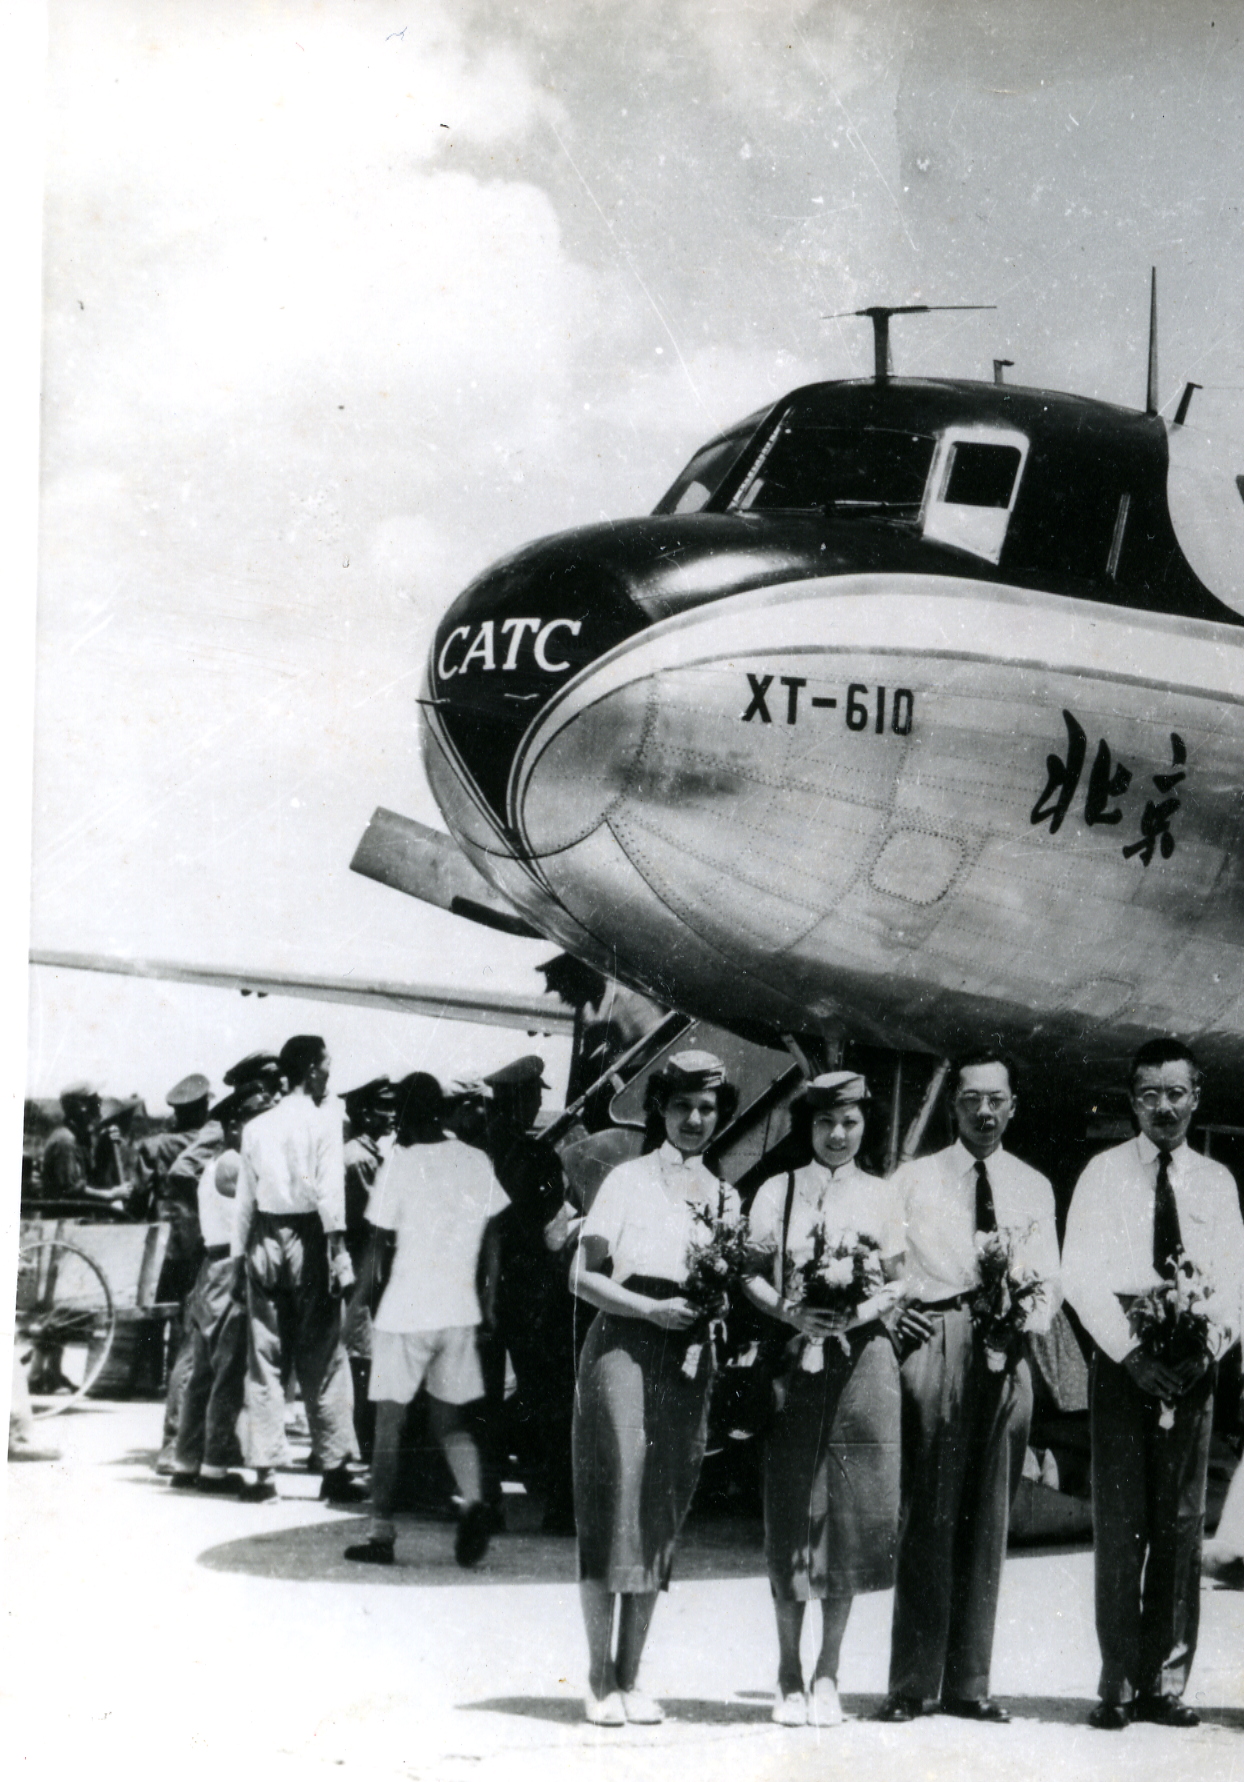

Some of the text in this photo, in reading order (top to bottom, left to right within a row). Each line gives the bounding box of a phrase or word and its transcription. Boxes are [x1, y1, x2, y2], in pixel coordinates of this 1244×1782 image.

[438, 617, 582, 681] CATC
[741, 673, 915, 735] XT-610
[1029, 708, 1188, 866] 北京
